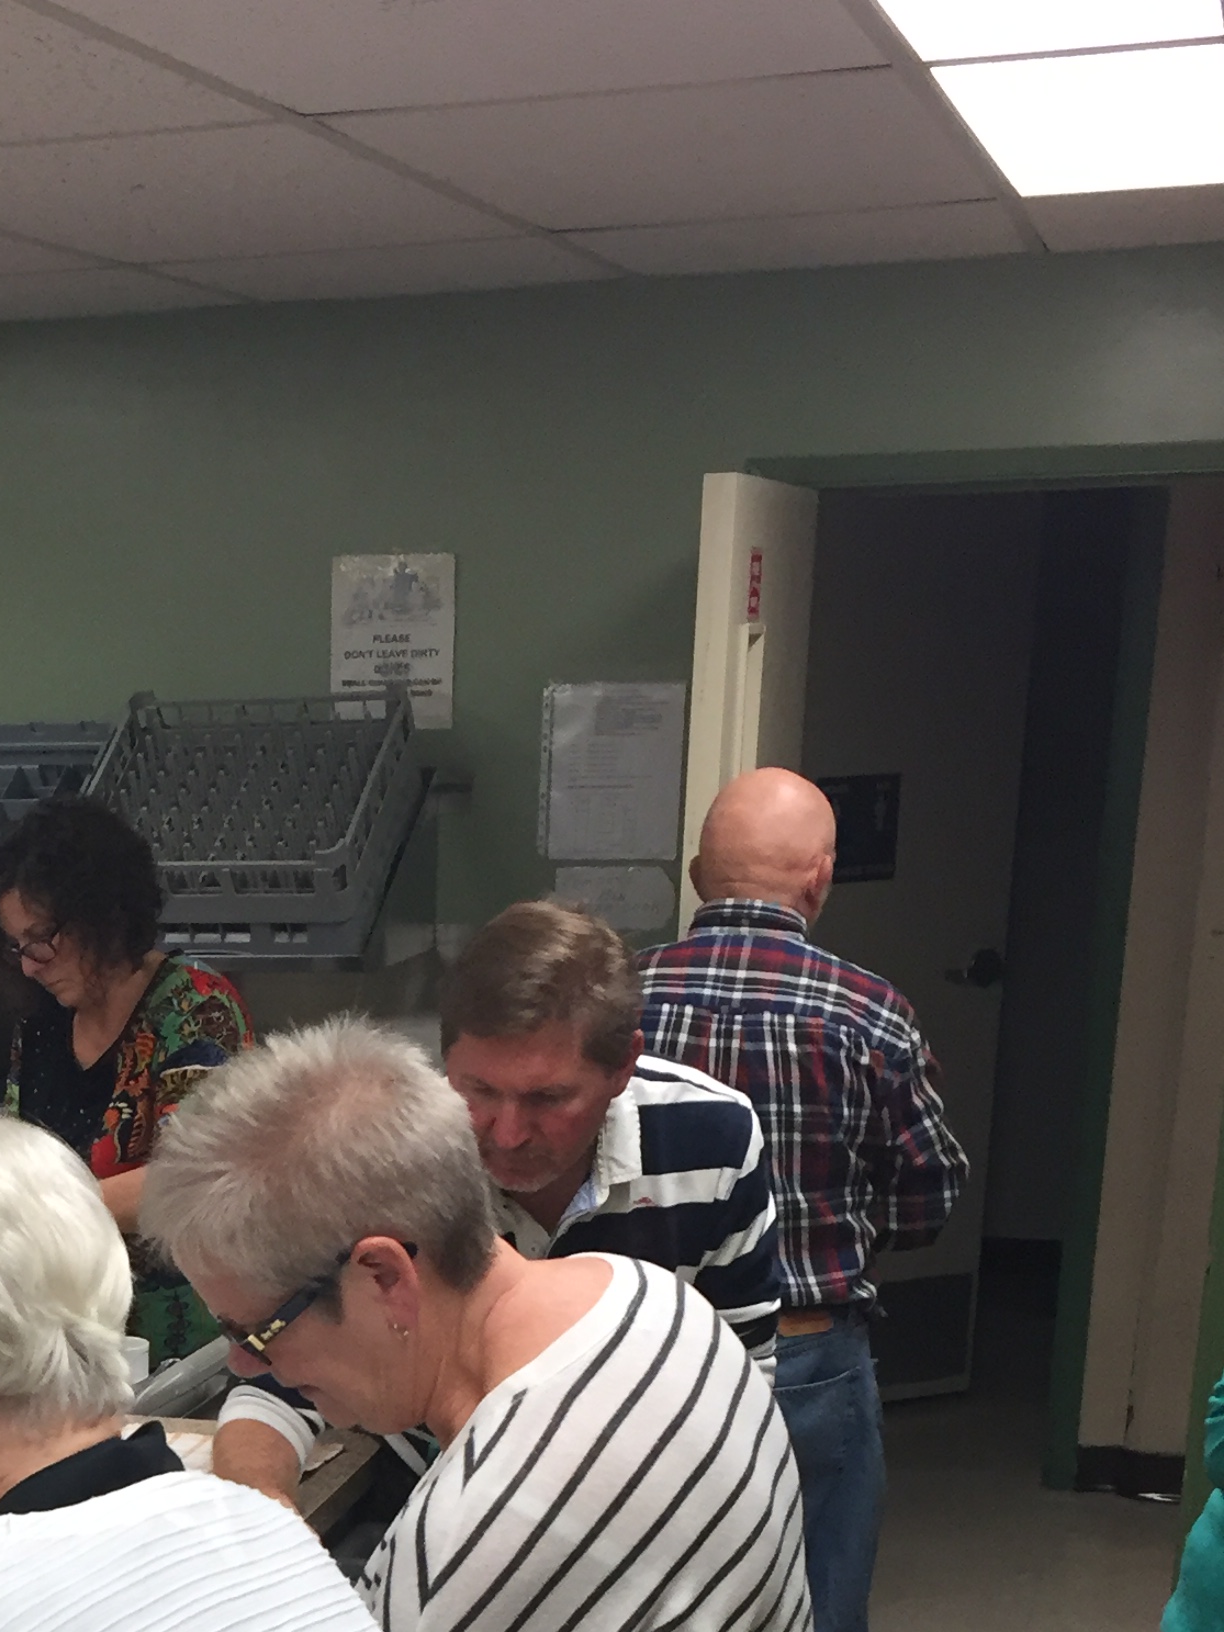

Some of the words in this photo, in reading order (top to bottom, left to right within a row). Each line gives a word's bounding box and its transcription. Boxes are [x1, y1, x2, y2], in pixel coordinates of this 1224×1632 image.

[373, 634, 411, 644] PLEASE
[344, 650, 373, 660] DON'T
[377, 649, 407, 659] LEAVE
[411, 648, 440, 658] DIRTY
